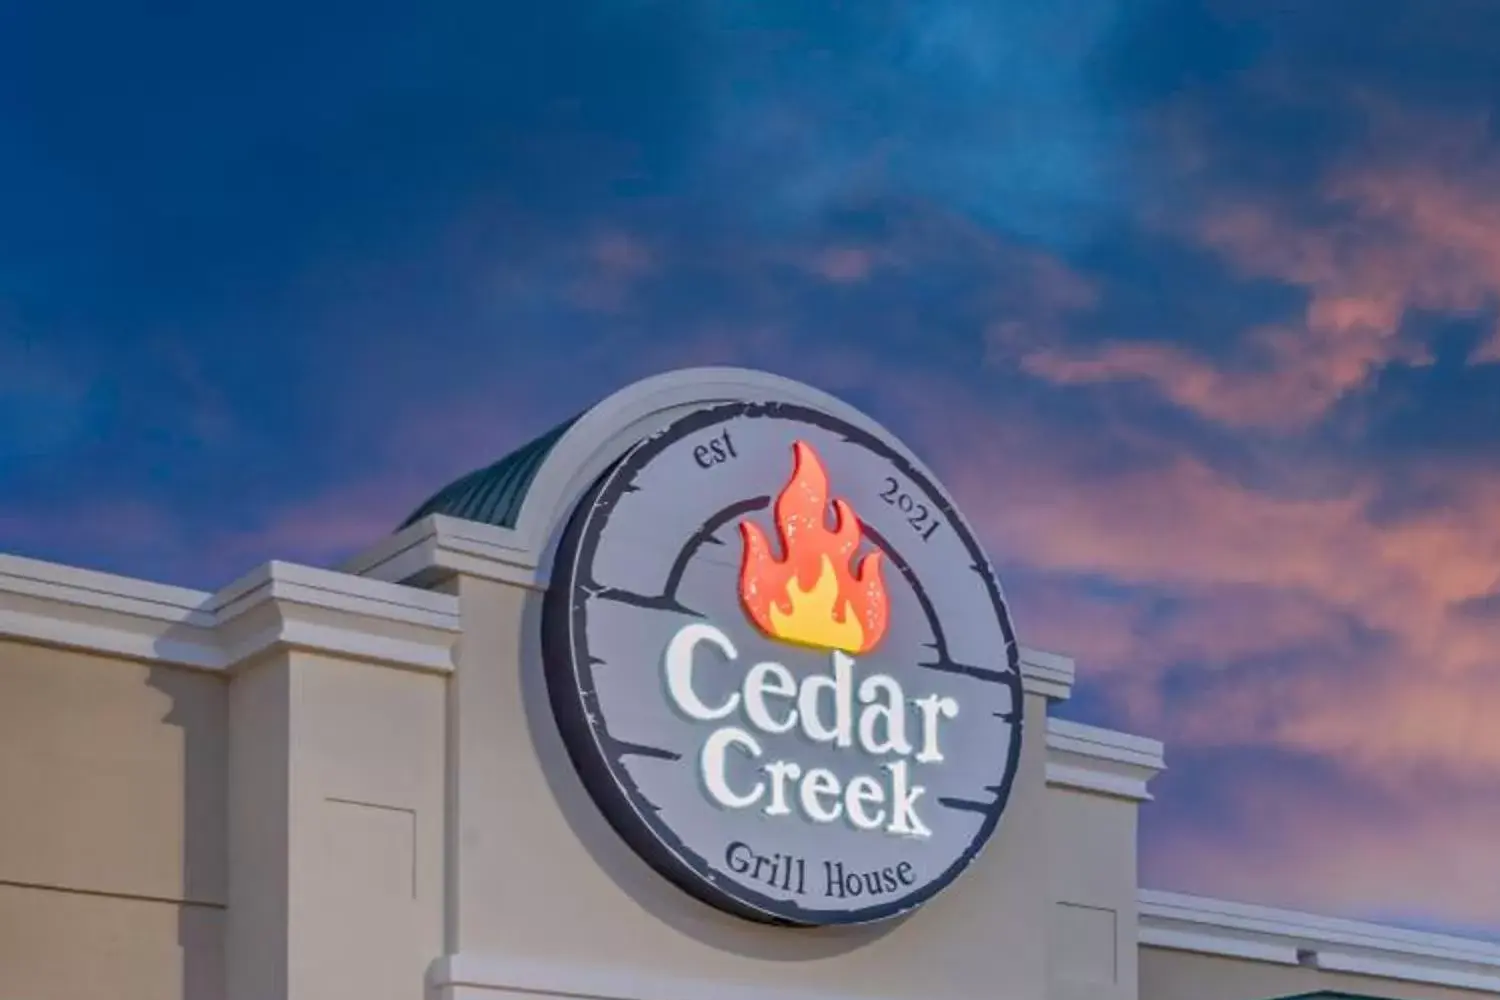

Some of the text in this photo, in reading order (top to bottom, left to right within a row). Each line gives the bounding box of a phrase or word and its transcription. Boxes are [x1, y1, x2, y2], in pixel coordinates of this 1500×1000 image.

[693, 428, 738, 470] est
[879, 477, 941, 542] 2021
[665, 624, 958, 763] Cedar
[701, 727, 931, 838] Creek
[725, 841, 916, 898] Grill House
